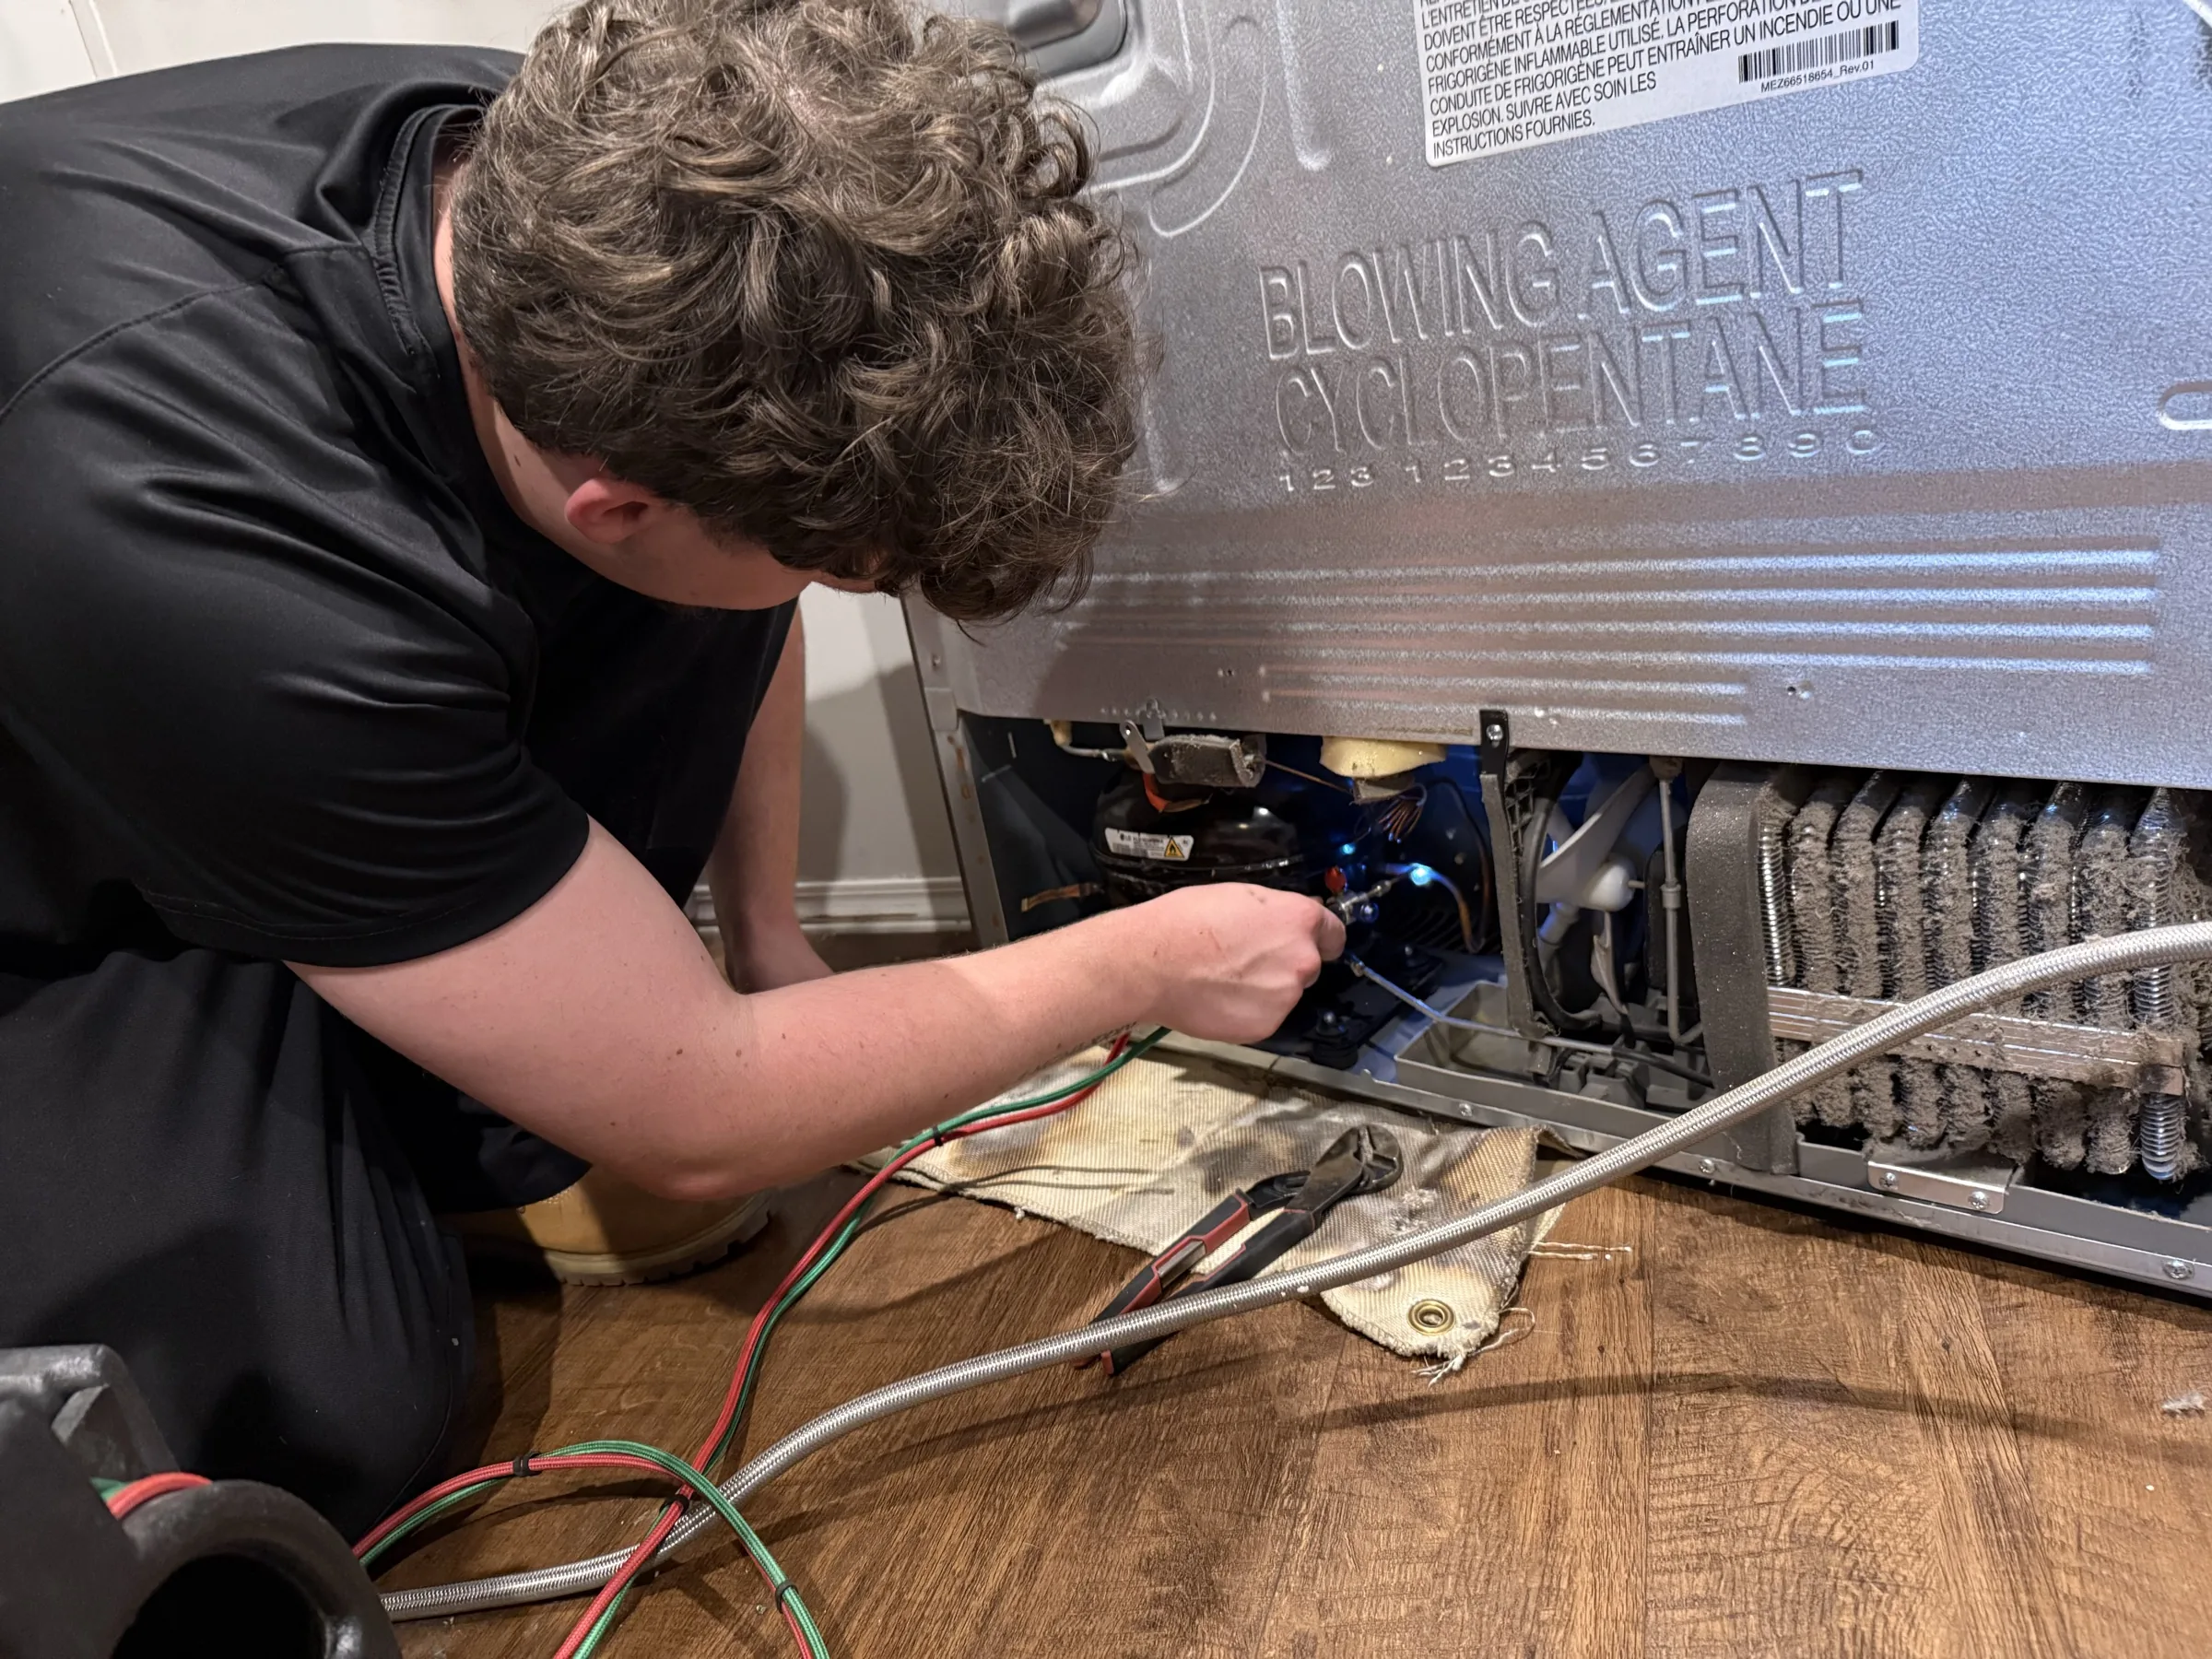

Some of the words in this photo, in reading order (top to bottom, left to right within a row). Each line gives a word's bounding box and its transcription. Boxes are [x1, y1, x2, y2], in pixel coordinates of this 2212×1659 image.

[1424, 21, 1477, 51] DOIVENT
[1479, 14, 1512, 37] ÊTRE
[1426, 29, 1532, 73] CONFORMÉMENT
[1535, 22, 1544, 46] À
[1546, 22, 1562, 42] LA
[1430, 86, 1492, 116] CONDUITE
[1495, 82, 1512, 100] DE
[1514, 59, 1606, 95] FRIGORIGÈNE
[1607, 49, 1644, 76] PEUT
[1648, 29, 1730, 66] ENTRAÎNER
[1734, 22, 1755, 45] UN
[1759, 4, 1833, 41] INCENDIE
[1837, 0, 1861, 21] OU
[1514, 35, 1606, 74] INFLAMMABLE
[1667, 16, 1685, 37] LA
[1432, 108, 1503, 137] EXPLOSION.
[1506, 94, 1552, 121] SUIVRE
[1555, 86, 1591, 110] AVEC
[1594, 79, 1627, 102] SOIN
[1630, 71, 1656, 95] LES
[1433, 124, 1524, 159] INSTRUCTIONS
[1525, 109, 1595, 139] FOURNIES.
[1259, 219, 1563, 360] BLOWING
[1575, 168, 1864, 321] AGENT
